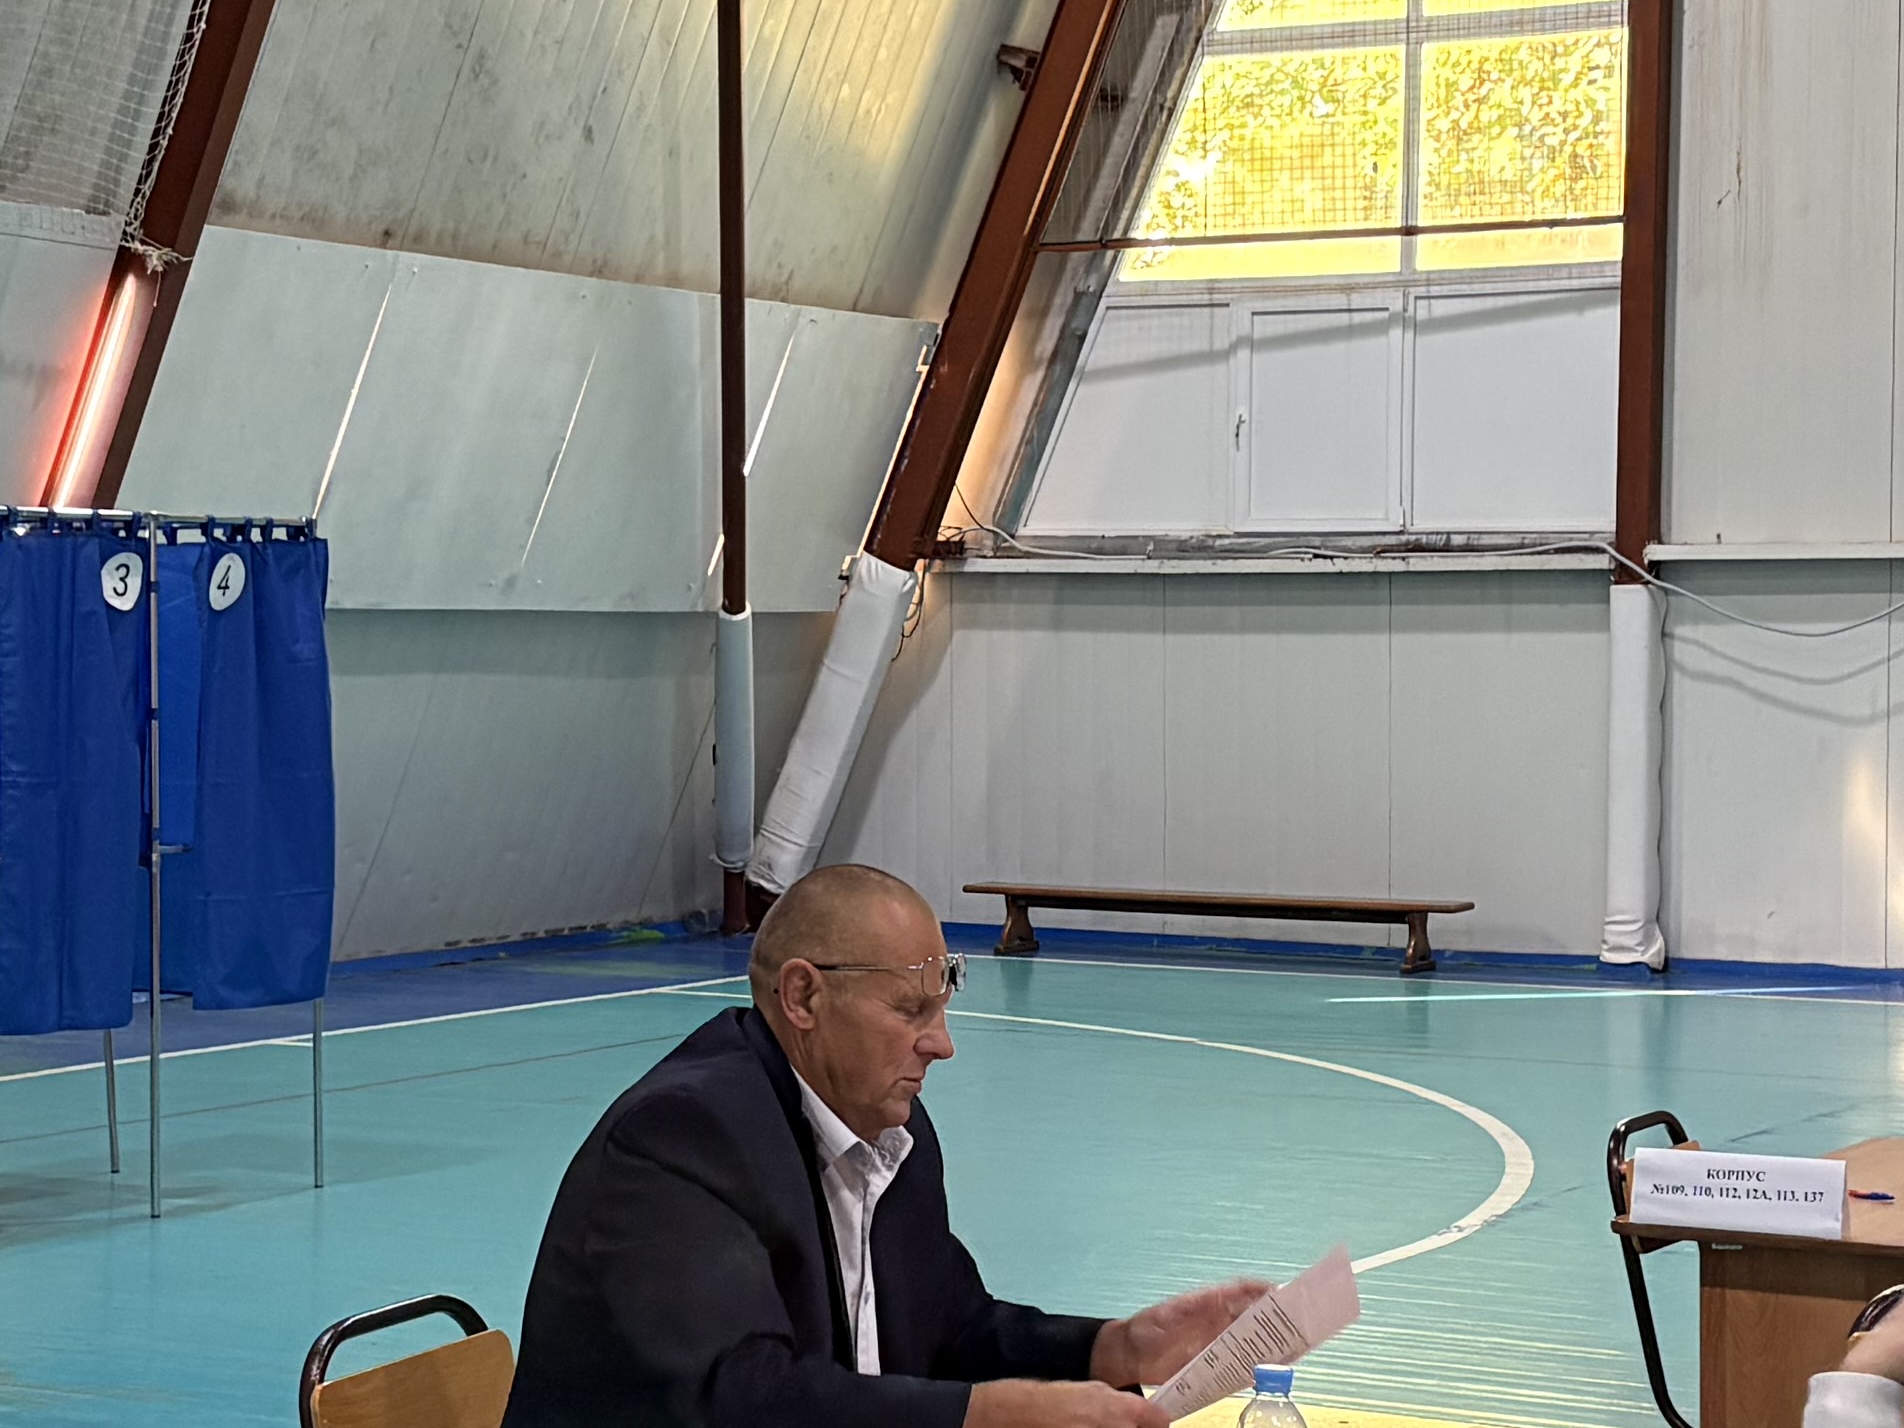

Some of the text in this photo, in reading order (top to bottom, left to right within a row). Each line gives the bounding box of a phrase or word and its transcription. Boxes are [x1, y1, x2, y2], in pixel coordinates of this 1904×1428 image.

[112, 563, 130, 597] 3
[216, 564, 232, 597] 4
[1706, 1168, 1766, 1182] КОРПУС
